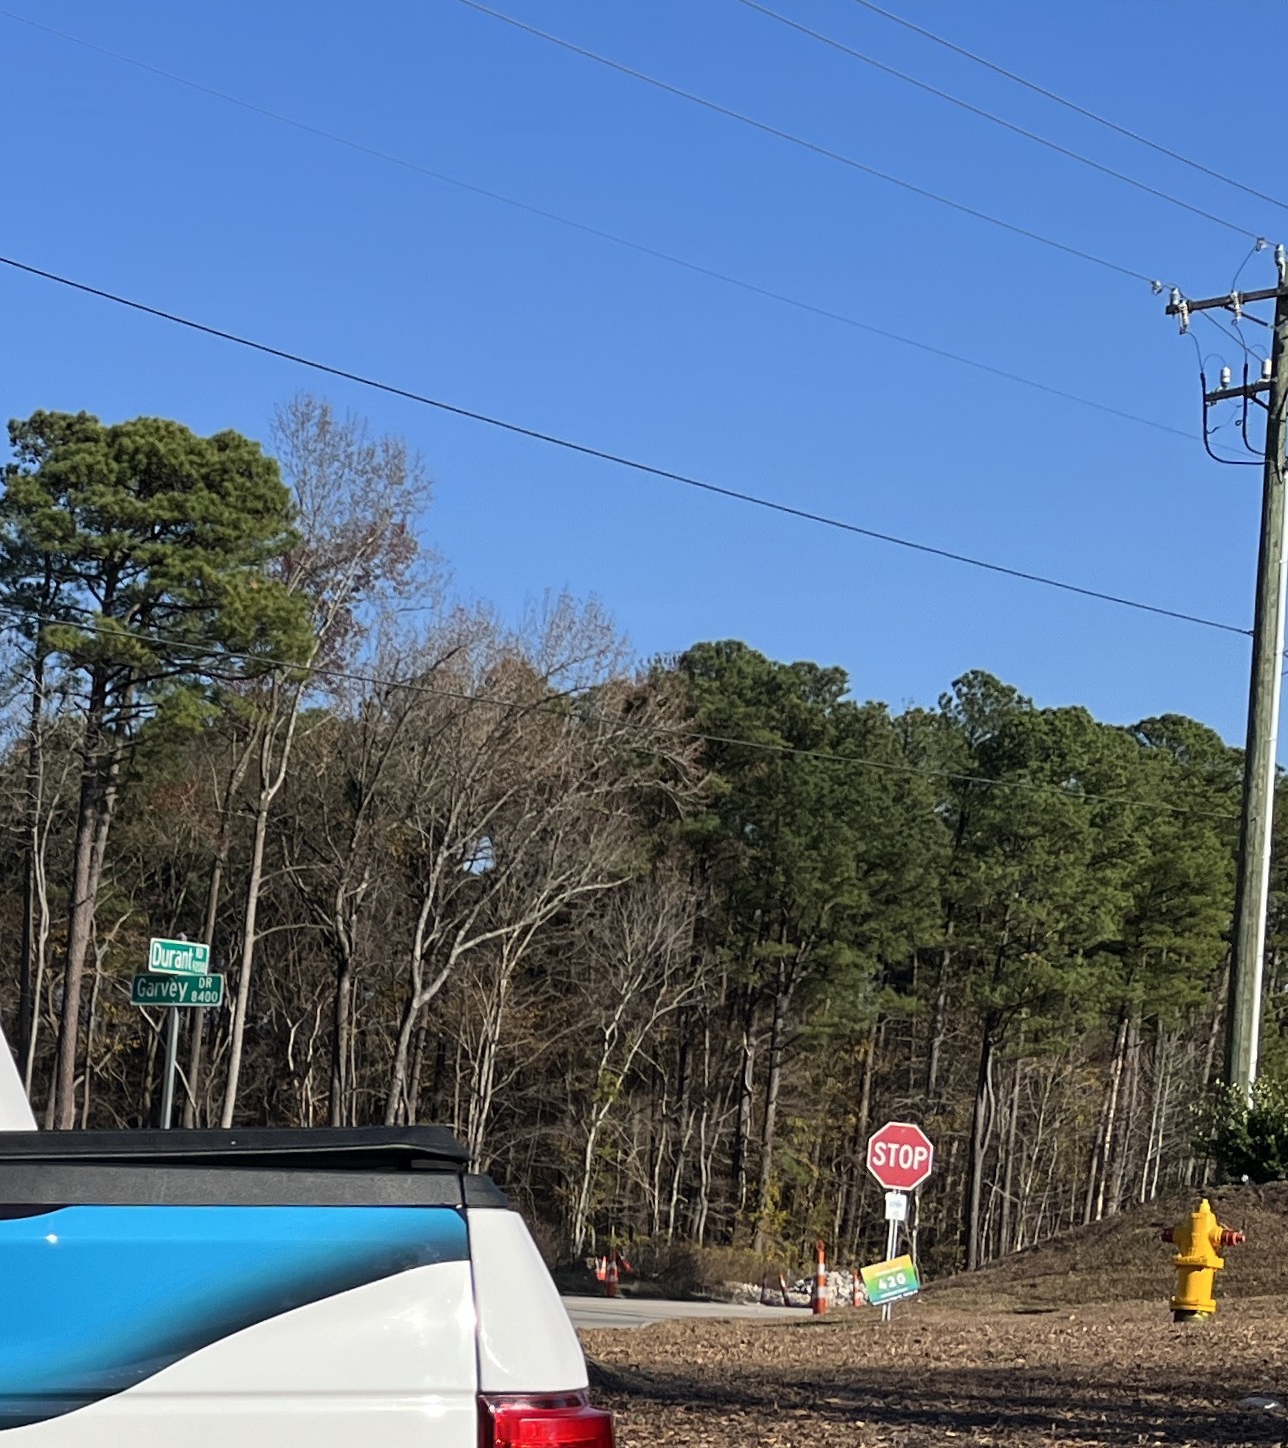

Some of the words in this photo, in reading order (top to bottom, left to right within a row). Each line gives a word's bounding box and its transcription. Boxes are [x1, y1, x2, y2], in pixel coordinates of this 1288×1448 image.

[152, 943, 194, 971] Durant
[137, 977, 189, 1003] Garvey
[198, 977, 213, 989] DR
[191, 990, 219, 1003] 8400
[872, 1140, 928, 1171] STOP
